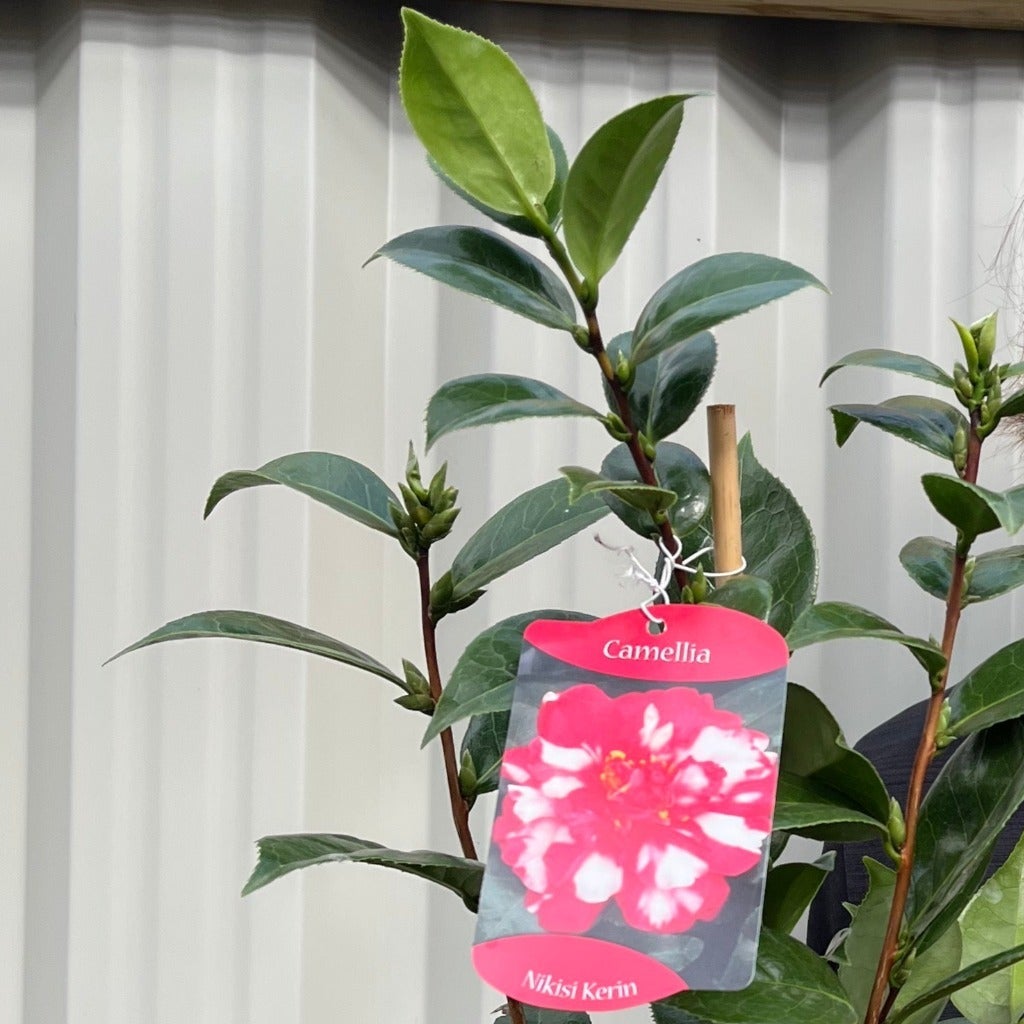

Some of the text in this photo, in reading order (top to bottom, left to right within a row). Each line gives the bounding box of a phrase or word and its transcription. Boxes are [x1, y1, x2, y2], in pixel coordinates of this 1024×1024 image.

[602, 639, 711, 664] Camellia
[521, 969, 638, 1001] Nikisi Kerin
